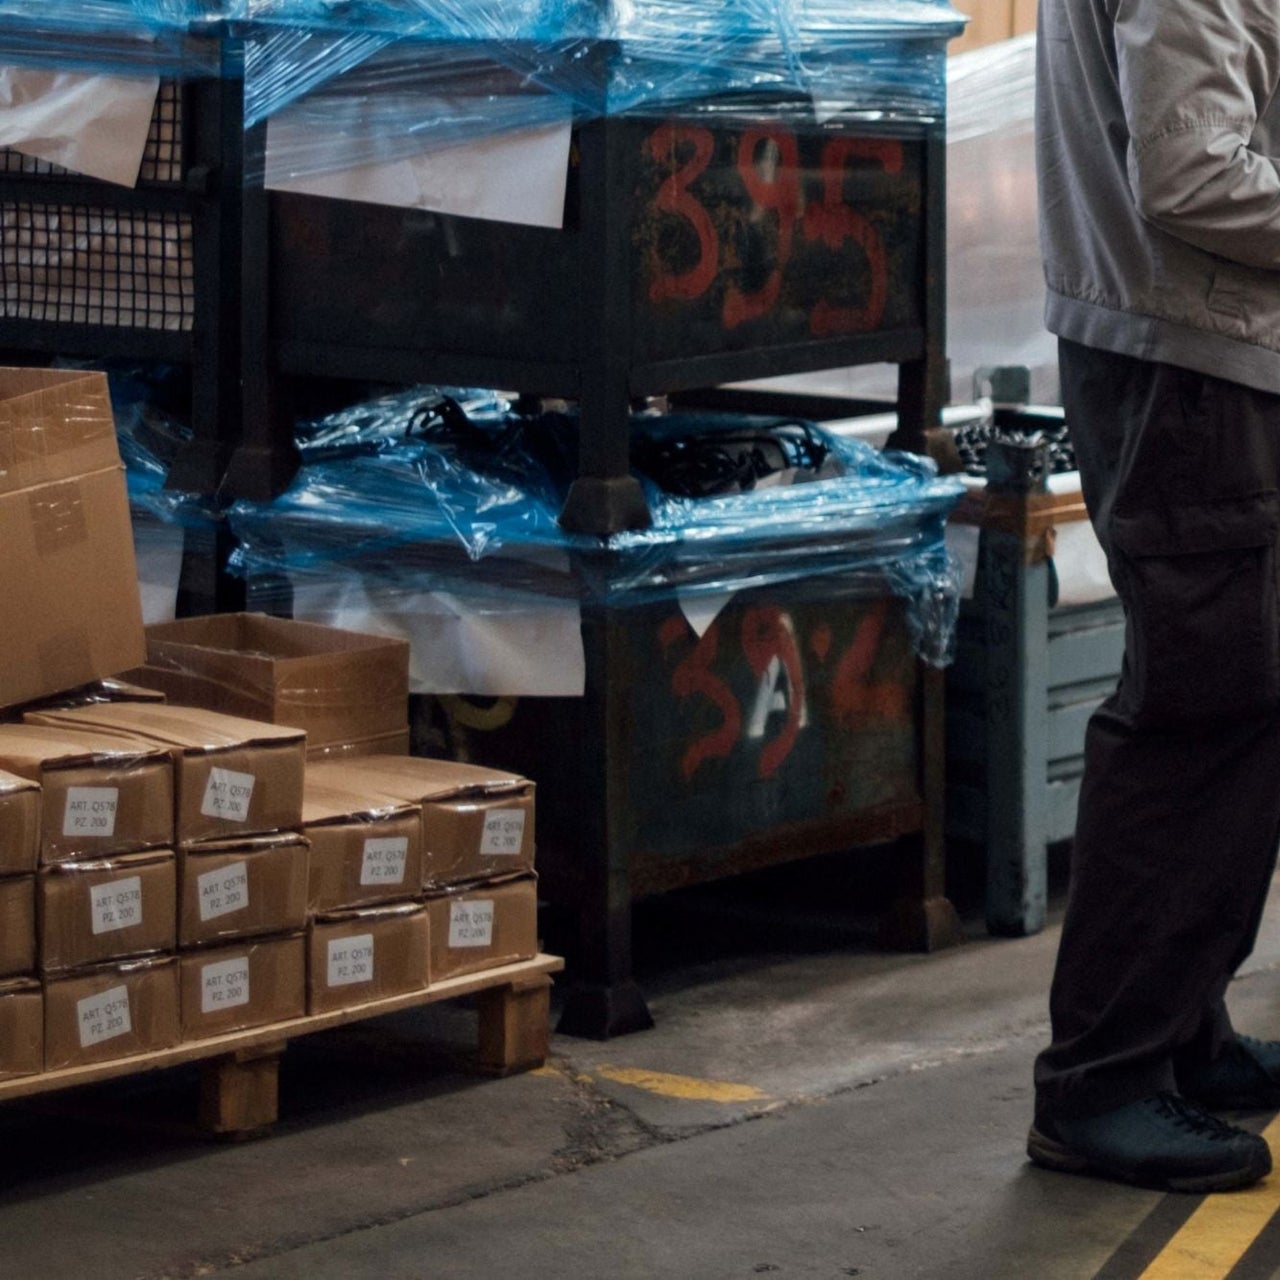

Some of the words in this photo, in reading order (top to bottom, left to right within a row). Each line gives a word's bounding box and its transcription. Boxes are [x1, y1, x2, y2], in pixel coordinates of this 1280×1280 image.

[645, 120, 904, 336] 395
[92, 801, 116, 812] Q578
[228, 801, 241, 812] 200
[90, 818, 107, 827] 200
[226, 892, 240, 905] 200
[119, 907, 134, 919] 200
[352, 964, 366, 974] 200
[228, 987, 242, 998] 200
[107, 1017, 122, 1030] 200
